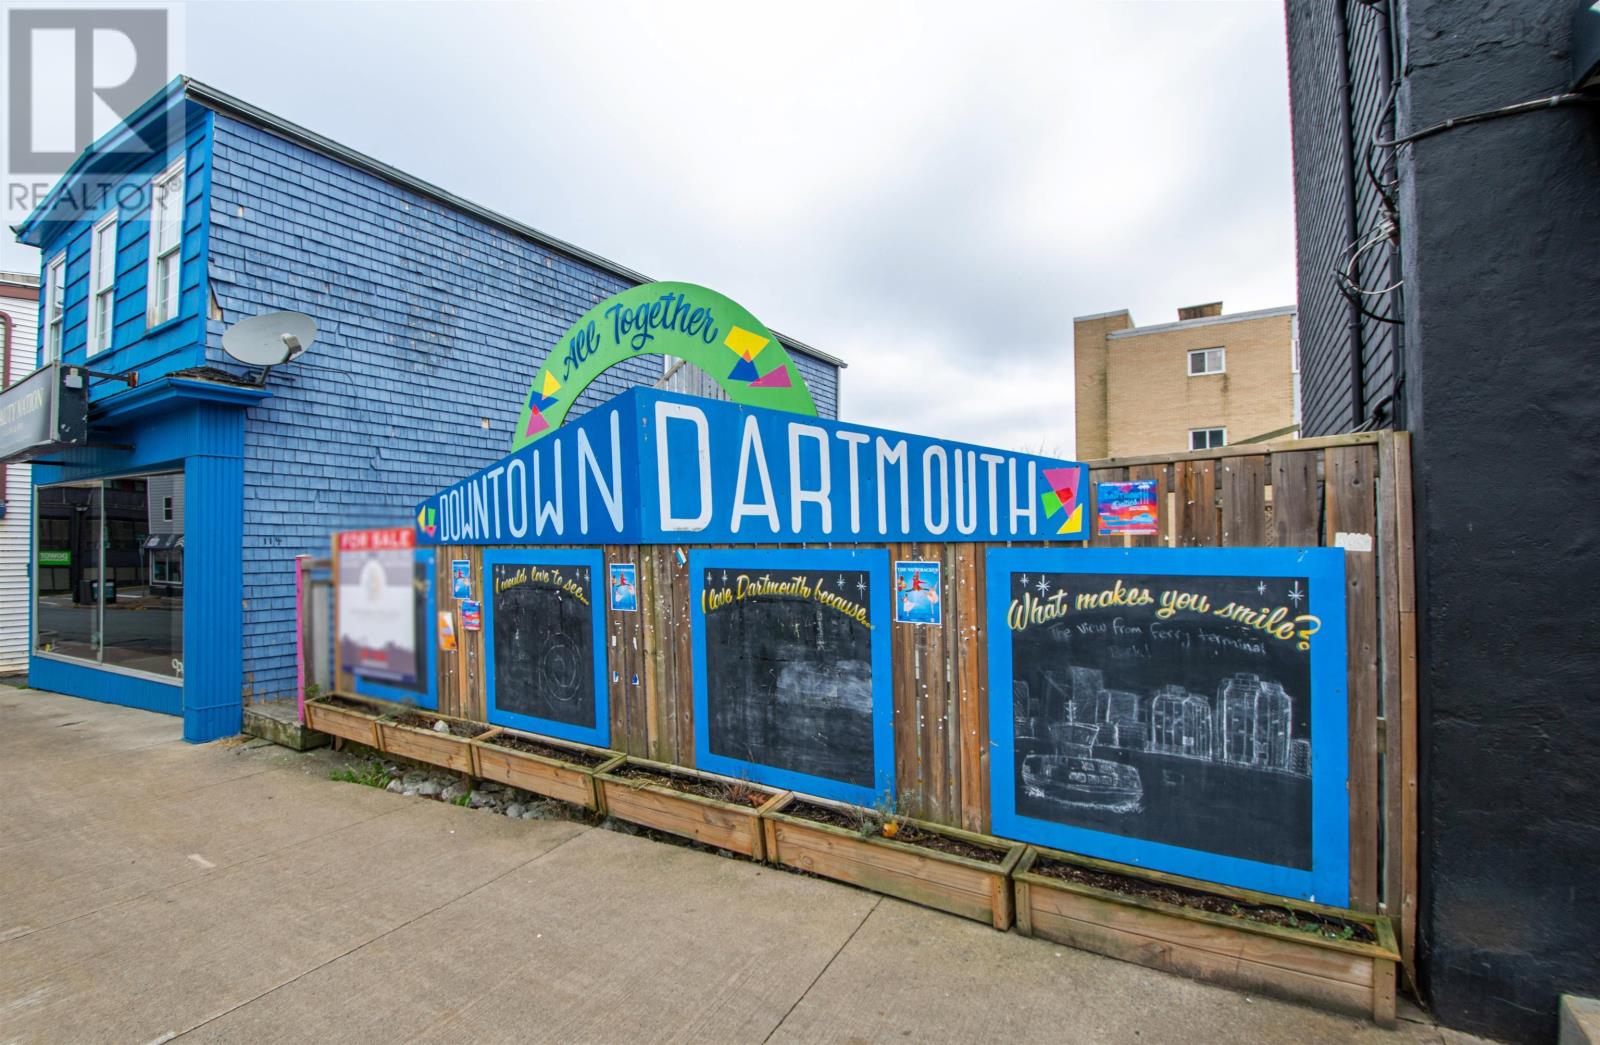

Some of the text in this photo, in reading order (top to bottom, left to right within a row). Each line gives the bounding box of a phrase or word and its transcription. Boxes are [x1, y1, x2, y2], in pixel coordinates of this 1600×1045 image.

[563, 292, 719, 382] All Together
[439, 400, 1038, 542] DOWNTOWN DARTMOUTH
[531, 565, 550, 583] love
[551, 569, 563, 586] to
[701, 589, 707, 615] I
[709, 588, 732, 610] love
[736, 574, 812, 600] Dartmouth
[1007, 579, 1322, 651] What makes you smile?
